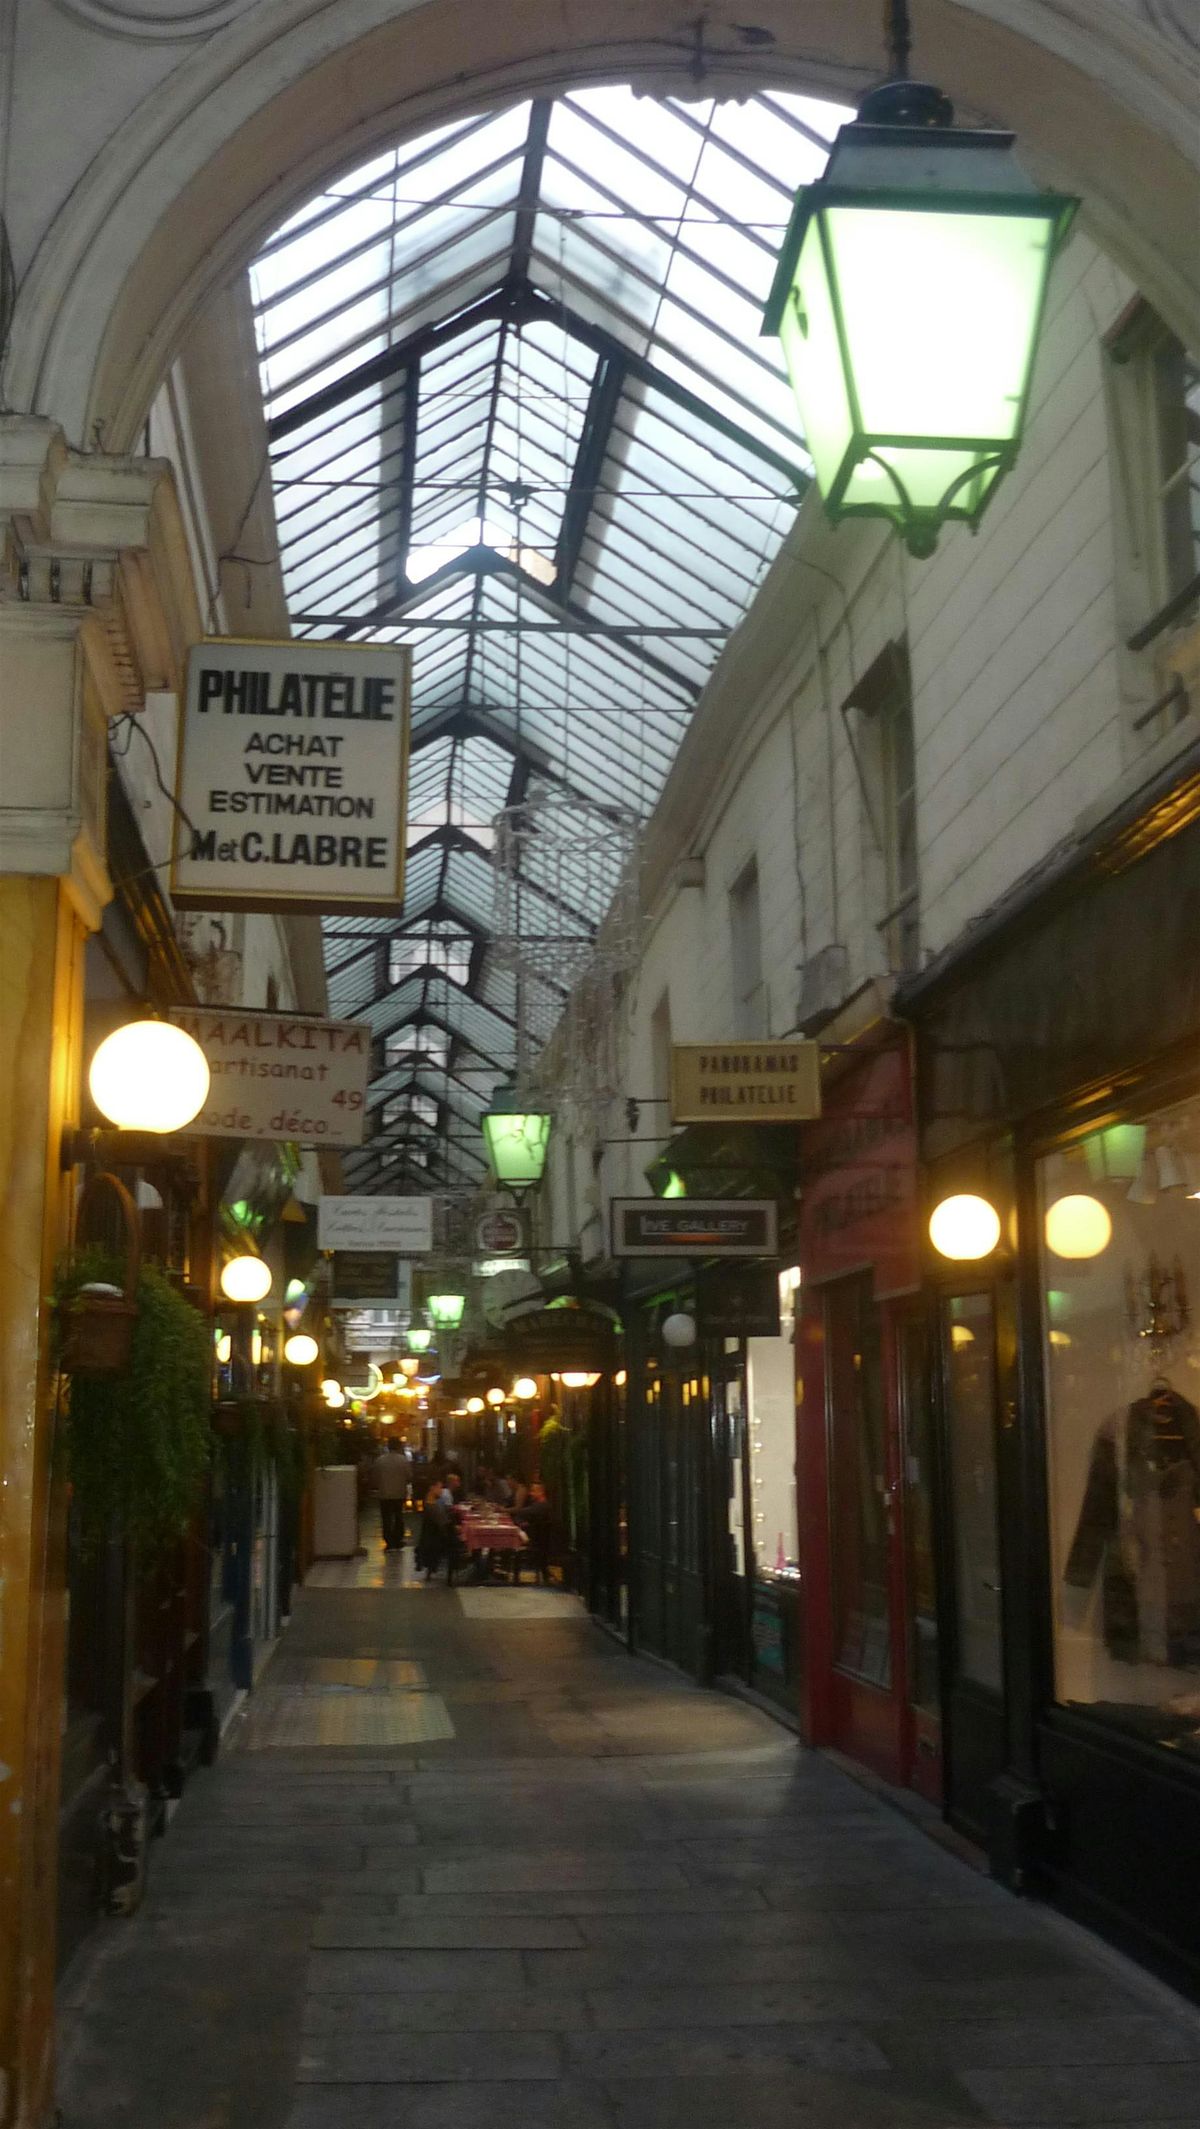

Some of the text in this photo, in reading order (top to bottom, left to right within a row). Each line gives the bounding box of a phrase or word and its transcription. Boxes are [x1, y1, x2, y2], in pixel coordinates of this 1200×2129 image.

[244, 732, 344, 758] ACHAT
[244, 762, 343, 788] VENTE
[208, 790, 375, 819] ESTIMATION
[210, 1056, 330, 1081] artisanat
[331, 1089, 363, 1111] 49
